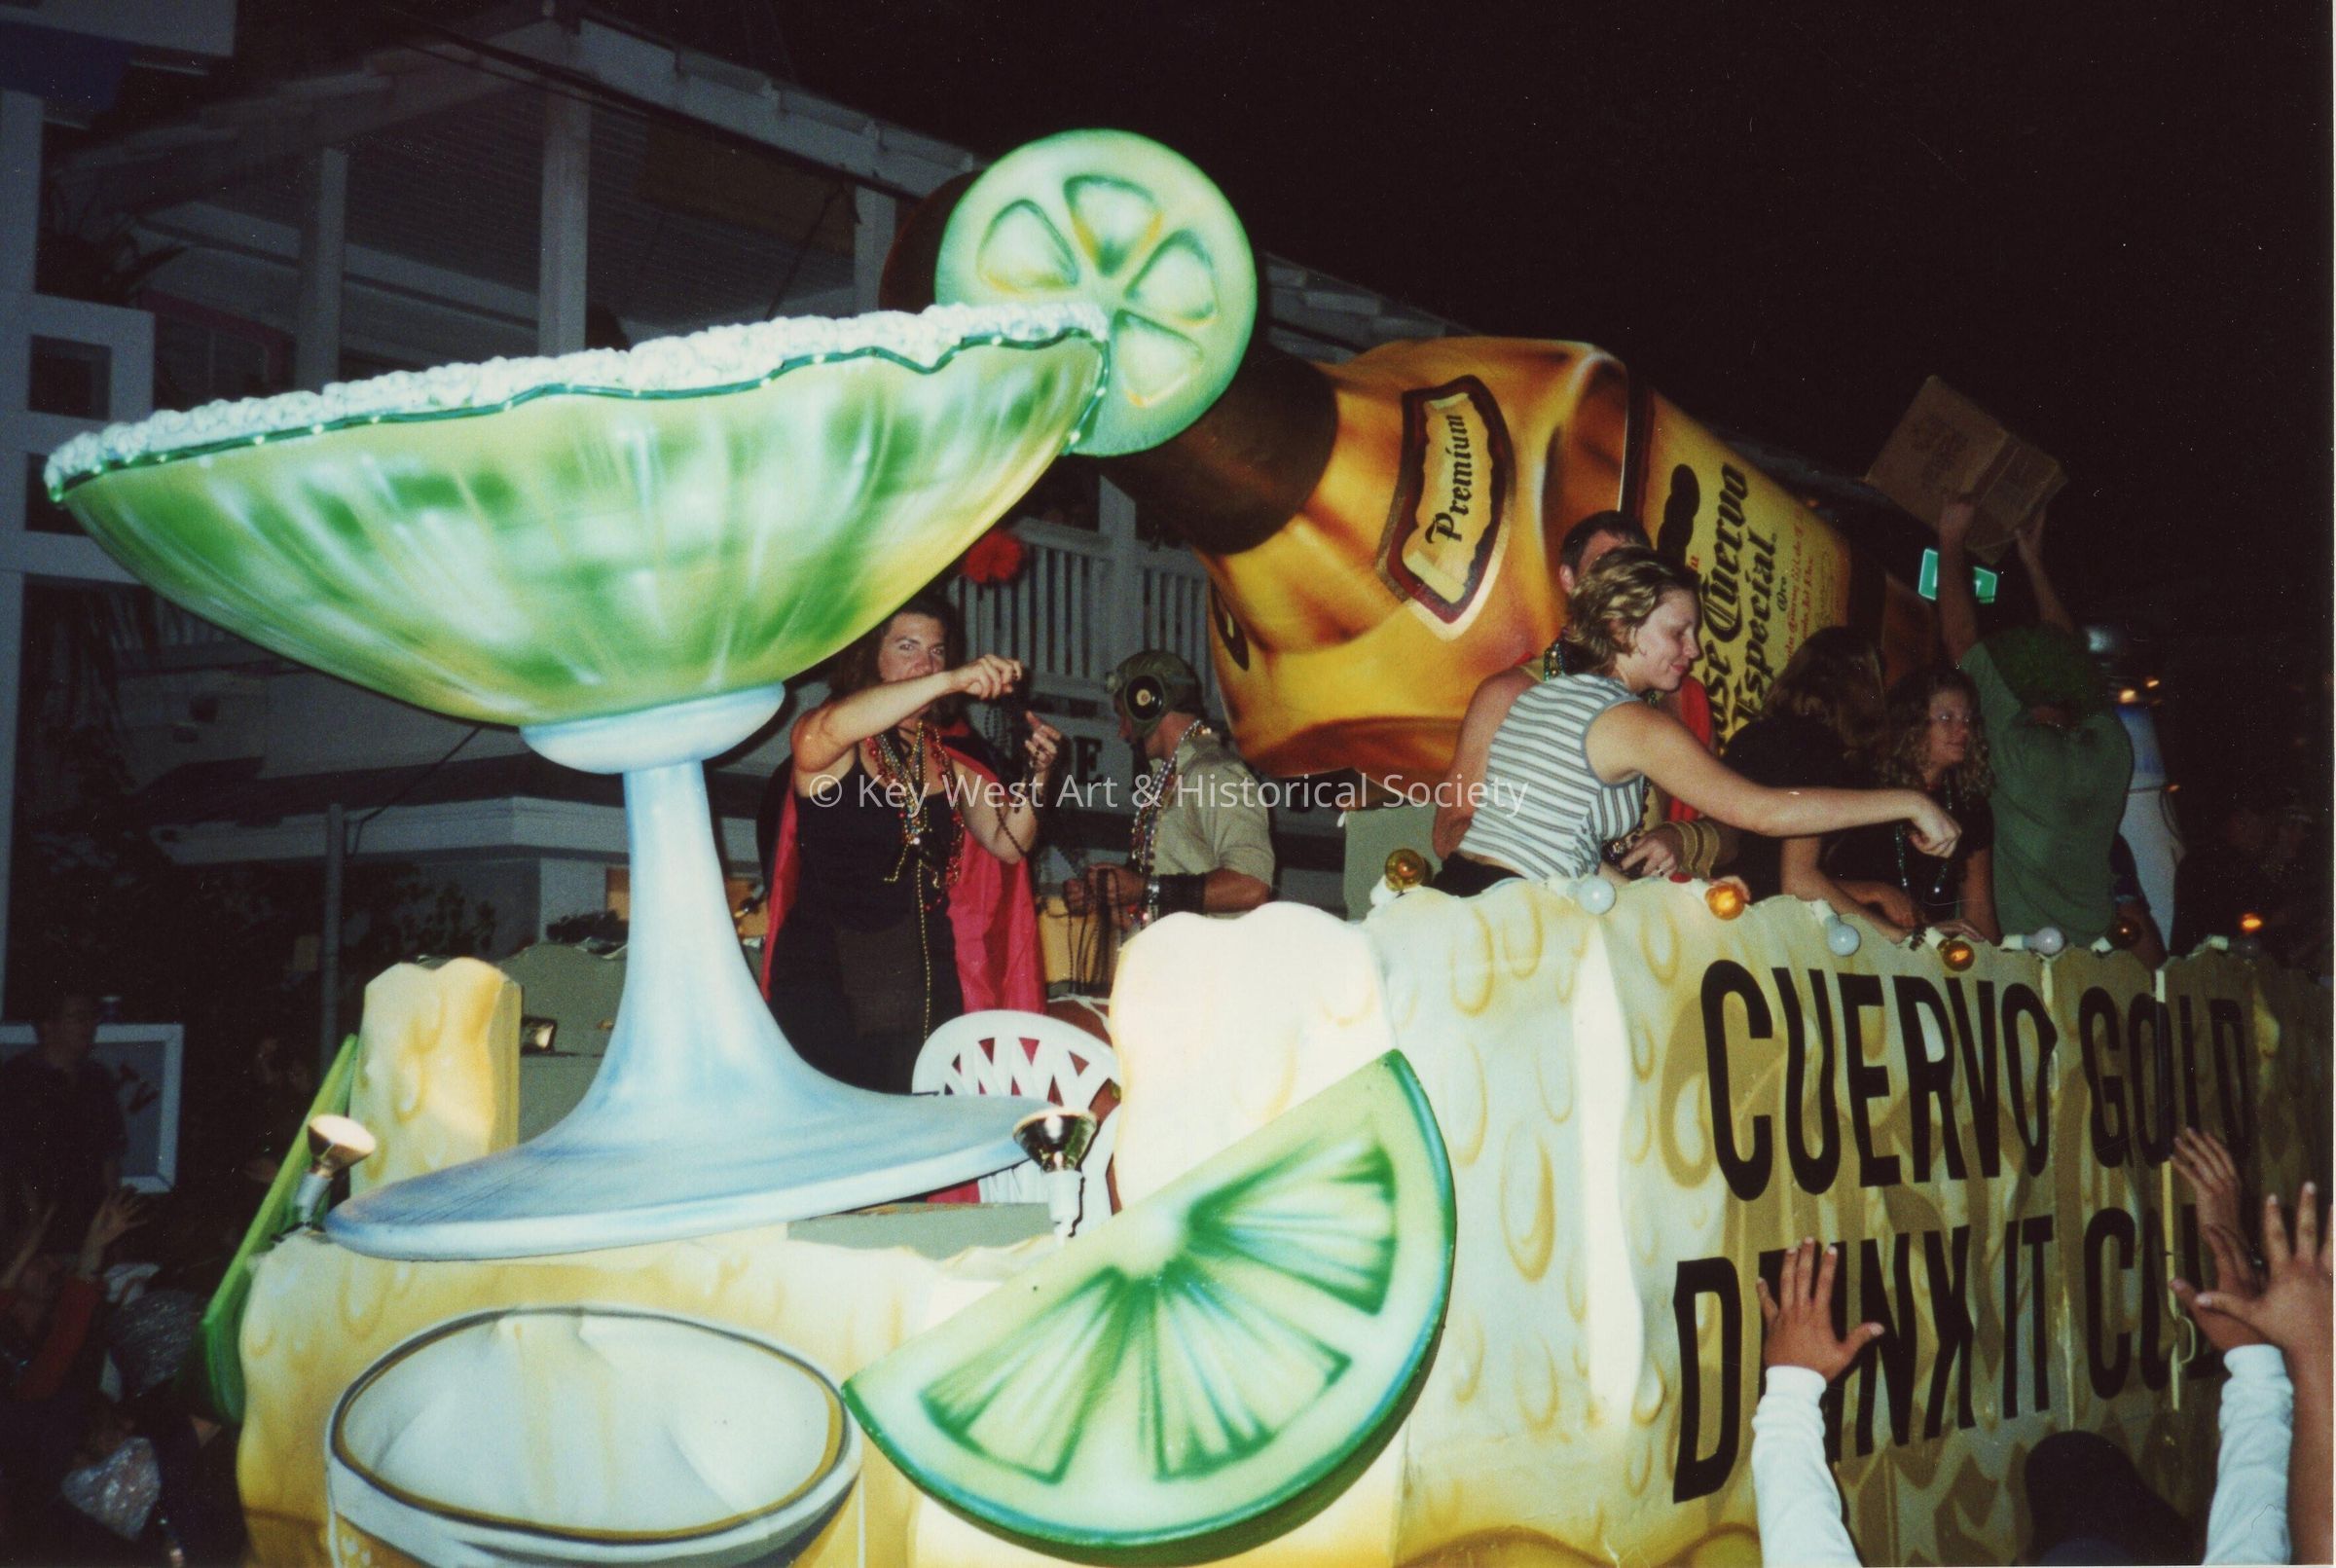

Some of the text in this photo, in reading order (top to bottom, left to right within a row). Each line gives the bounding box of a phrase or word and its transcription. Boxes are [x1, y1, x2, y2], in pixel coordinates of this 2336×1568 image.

[1424, 414, 1473, 545] Premium
[1700, 462, 1749, 643] Cuervo
[1700, 960, 2250, 1201] CUERVO GOLD
[2002, 1214, 2054, 1420] IT
